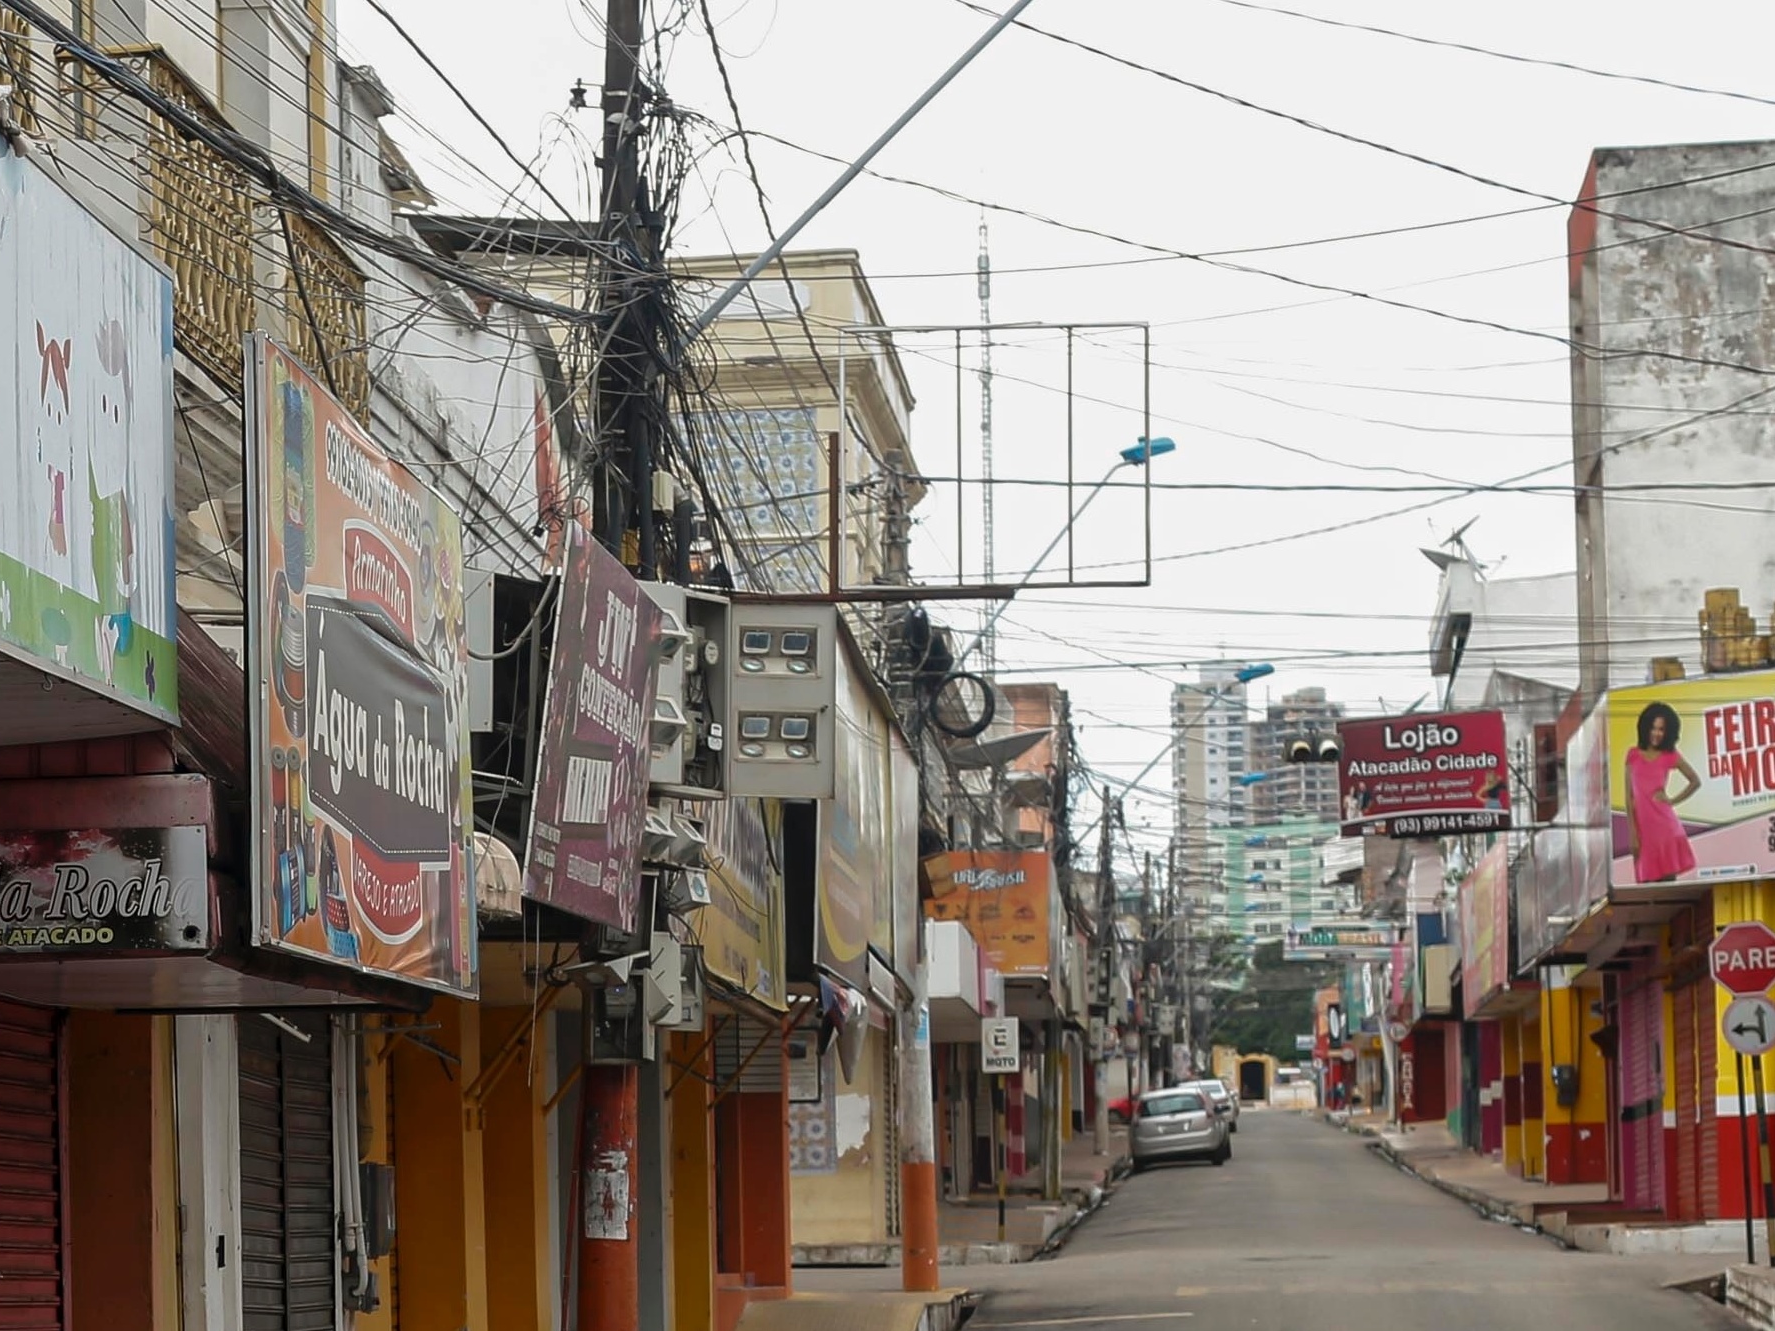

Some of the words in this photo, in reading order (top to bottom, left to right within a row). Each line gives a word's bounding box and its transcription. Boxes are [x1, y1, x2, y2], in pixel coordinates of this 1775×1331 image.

[352, 535, 406, 624] Armarinho
[1385, 723, 1459, 752] Lojão
[373, 714, 390, 790] da
[394, 698, 445, 813] Rocha
[1347, 756, 1432, 777] Atacadão
[1435, 752, 1498, 771] Cidade
[1709, 755, 1731, 779] DA
[43, 858, 206, 919] Rocha
[8, 926, 114, 946] ATACADO
[1715, 946, 1775, 973] PARE
[986, 1056, 1015, 1067] MOTO
